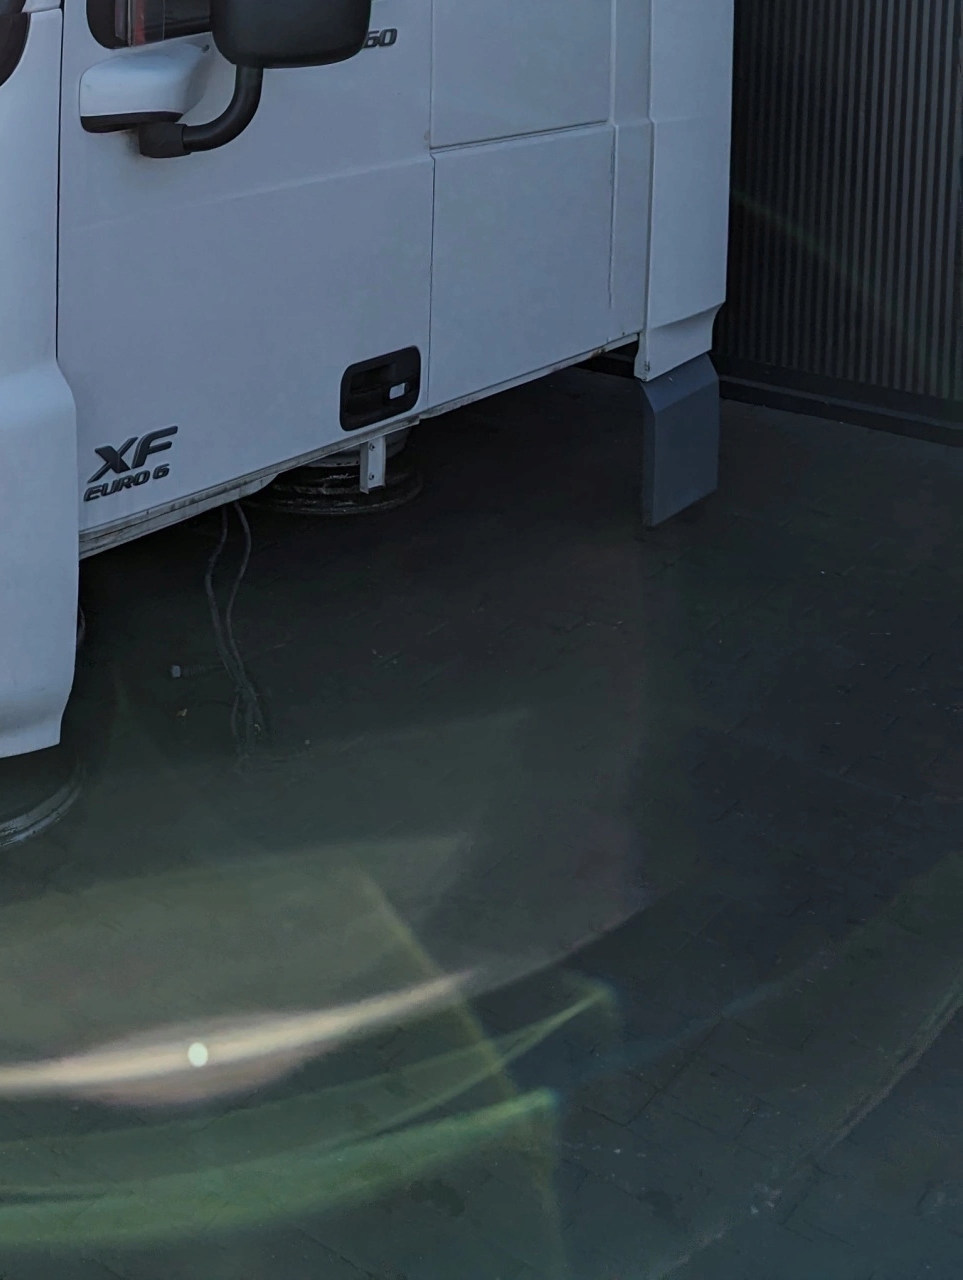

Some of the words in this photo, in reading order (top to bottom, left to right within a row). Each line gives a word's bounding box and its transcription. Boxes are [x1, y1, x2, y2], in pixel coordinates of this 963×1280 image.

[87, 425, 179, 484] XF
[83, 470, 151, 502] EURO
[152, 463, 170, 480] 6
